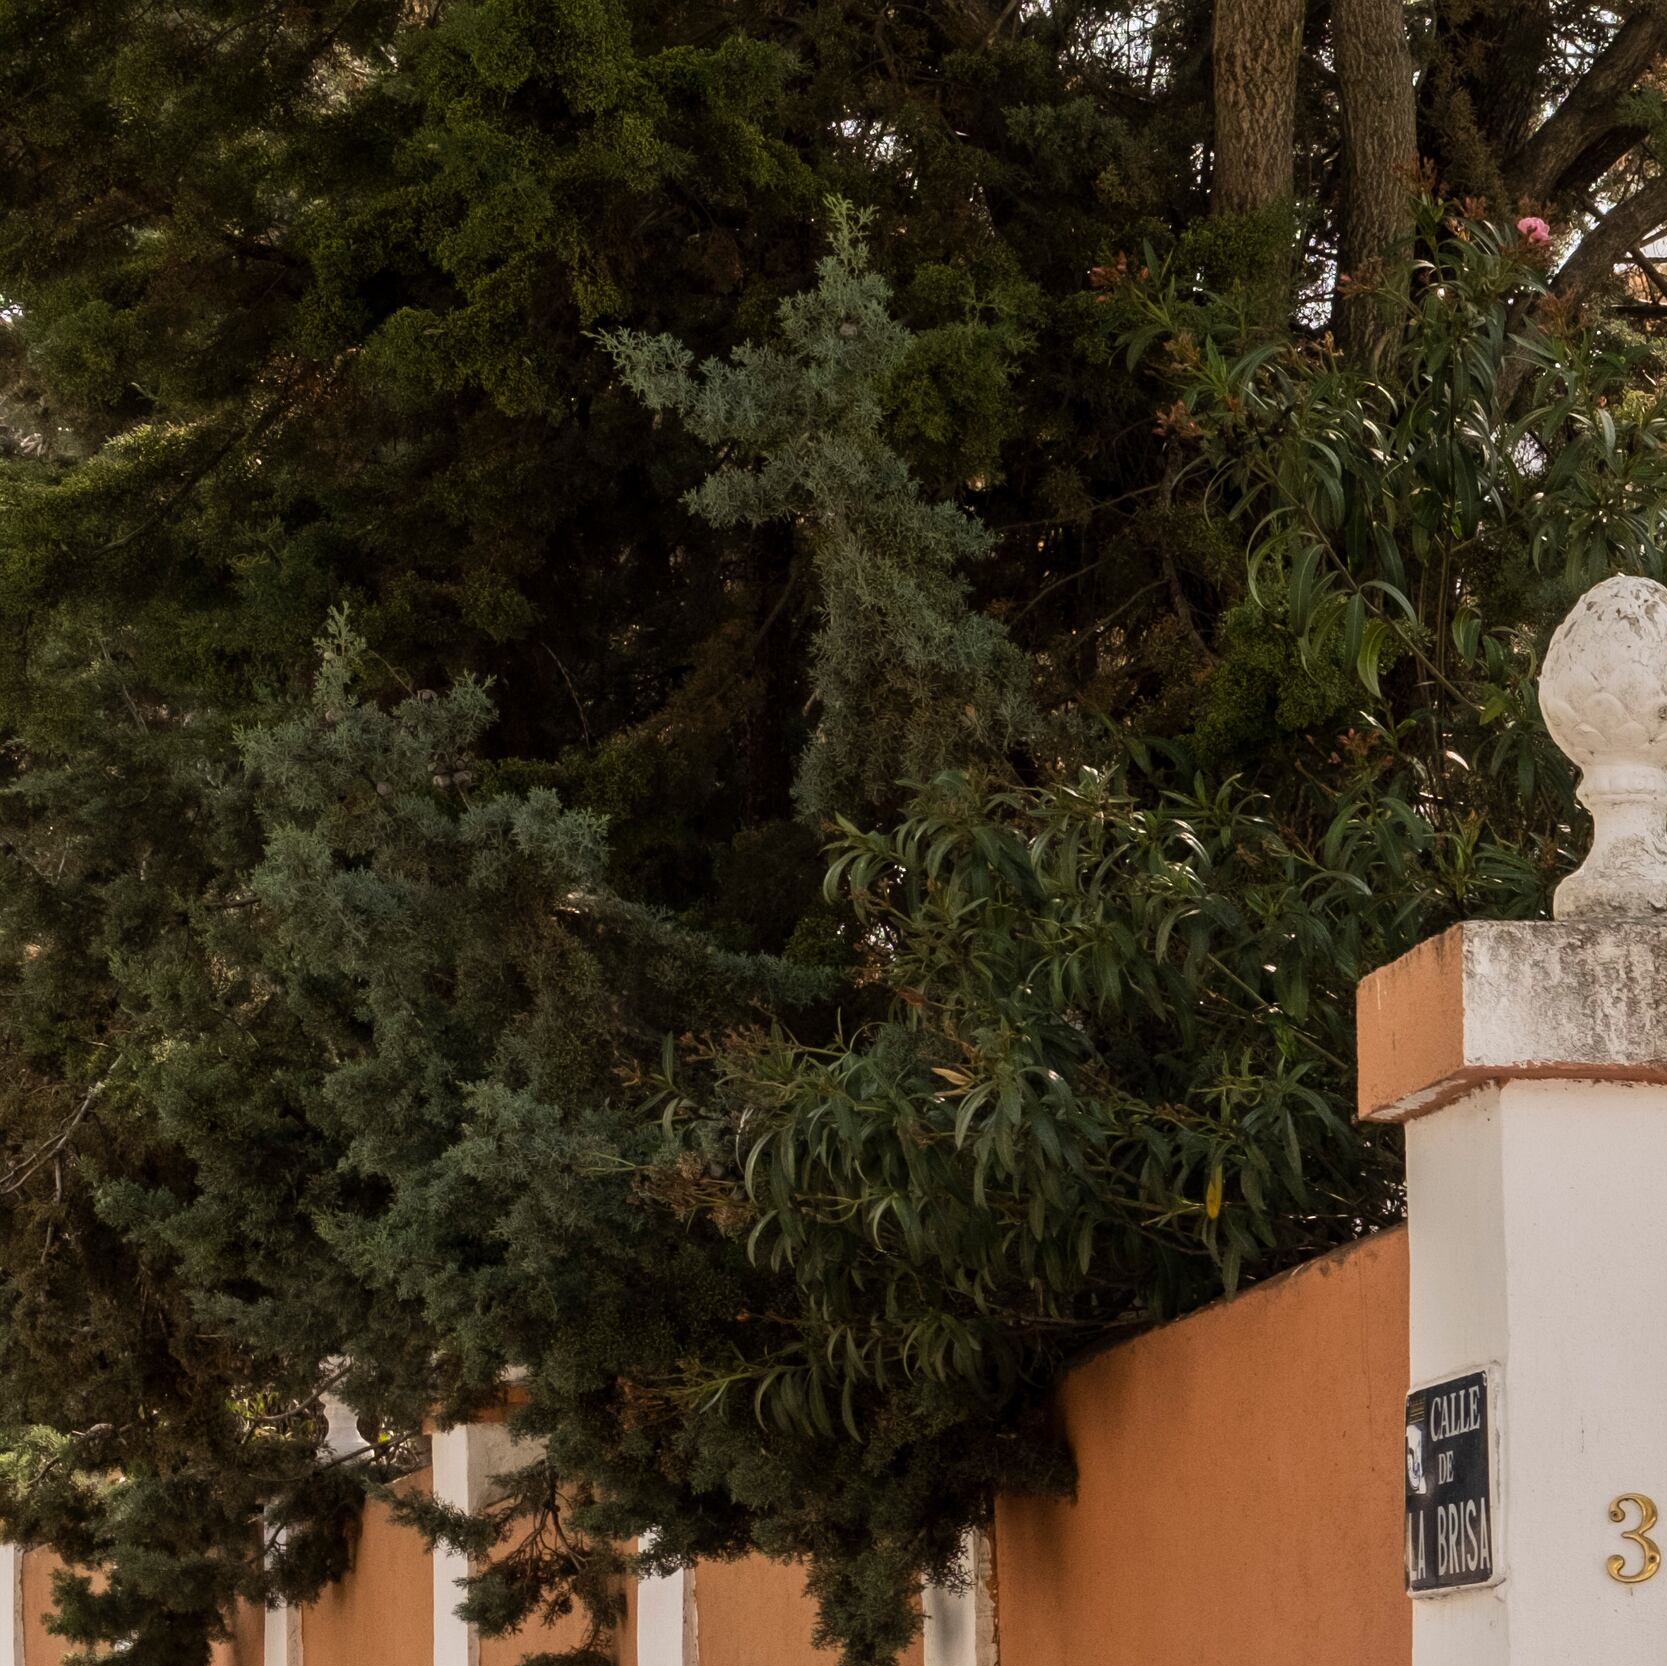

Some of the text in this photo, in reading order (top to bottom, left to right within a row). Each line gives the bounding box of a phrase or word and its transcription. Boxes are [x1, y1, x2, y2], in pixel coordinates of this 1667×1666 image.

[1430, 1385, 1480, 1442] CALLE
[1437, 1450, 1455, 1485] DE
[1407, 1497, 1491, 1581] LA BRISA
[1607, 1492, 1662, 1584] 3
